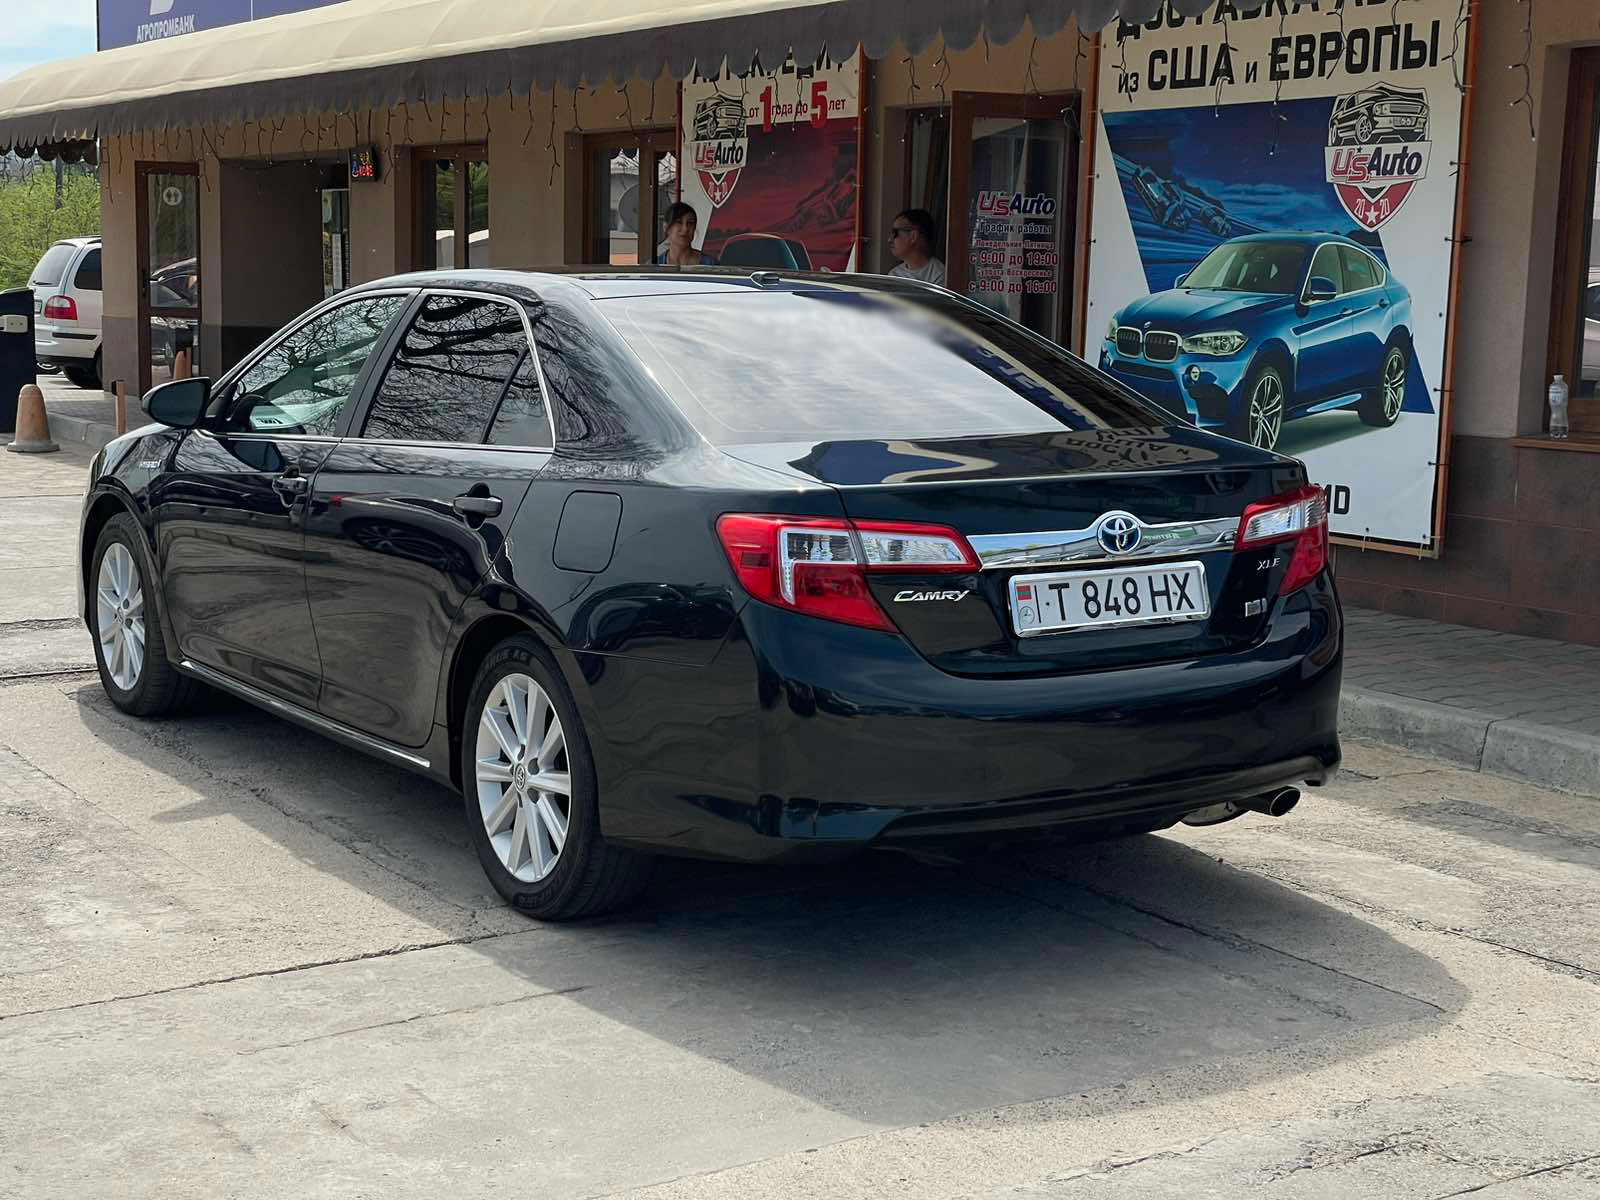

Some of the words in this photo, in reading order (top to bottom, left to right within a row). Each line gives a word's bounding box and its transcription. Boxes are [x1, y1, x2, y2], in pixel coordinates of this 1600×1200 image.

[136, 14, 195, 42] АГРОПРОМБАНК
[1118, 72, 1139, 94] из
[1147, 43, 1235, 91] США
[1245, 61, 1257, 83] и
[1269, 20, 1440, 81] ЕВРОПЫ
[749, 107, 760, 119] от
[760, 85, 772, 133] 1
[810, 80, 828, 129] 5
[828, 98, 846, 111] лет
[980, 251, 1005, 264] 9:00
[1008, 255, 1024, 265] до
[1027, 251, 1058, 265] 19:00
[980, 279, 1005, 292] 9:00
[1008, 283, 1022, 293] до
[1257, 557, 1281, 570] XLE
[893, 589, 970, 602] CAMRY
[1048, 582, 1071, 622] T
[1082, 576, 1142, 619] 848
[1148, 572, 1196, 613] HX
